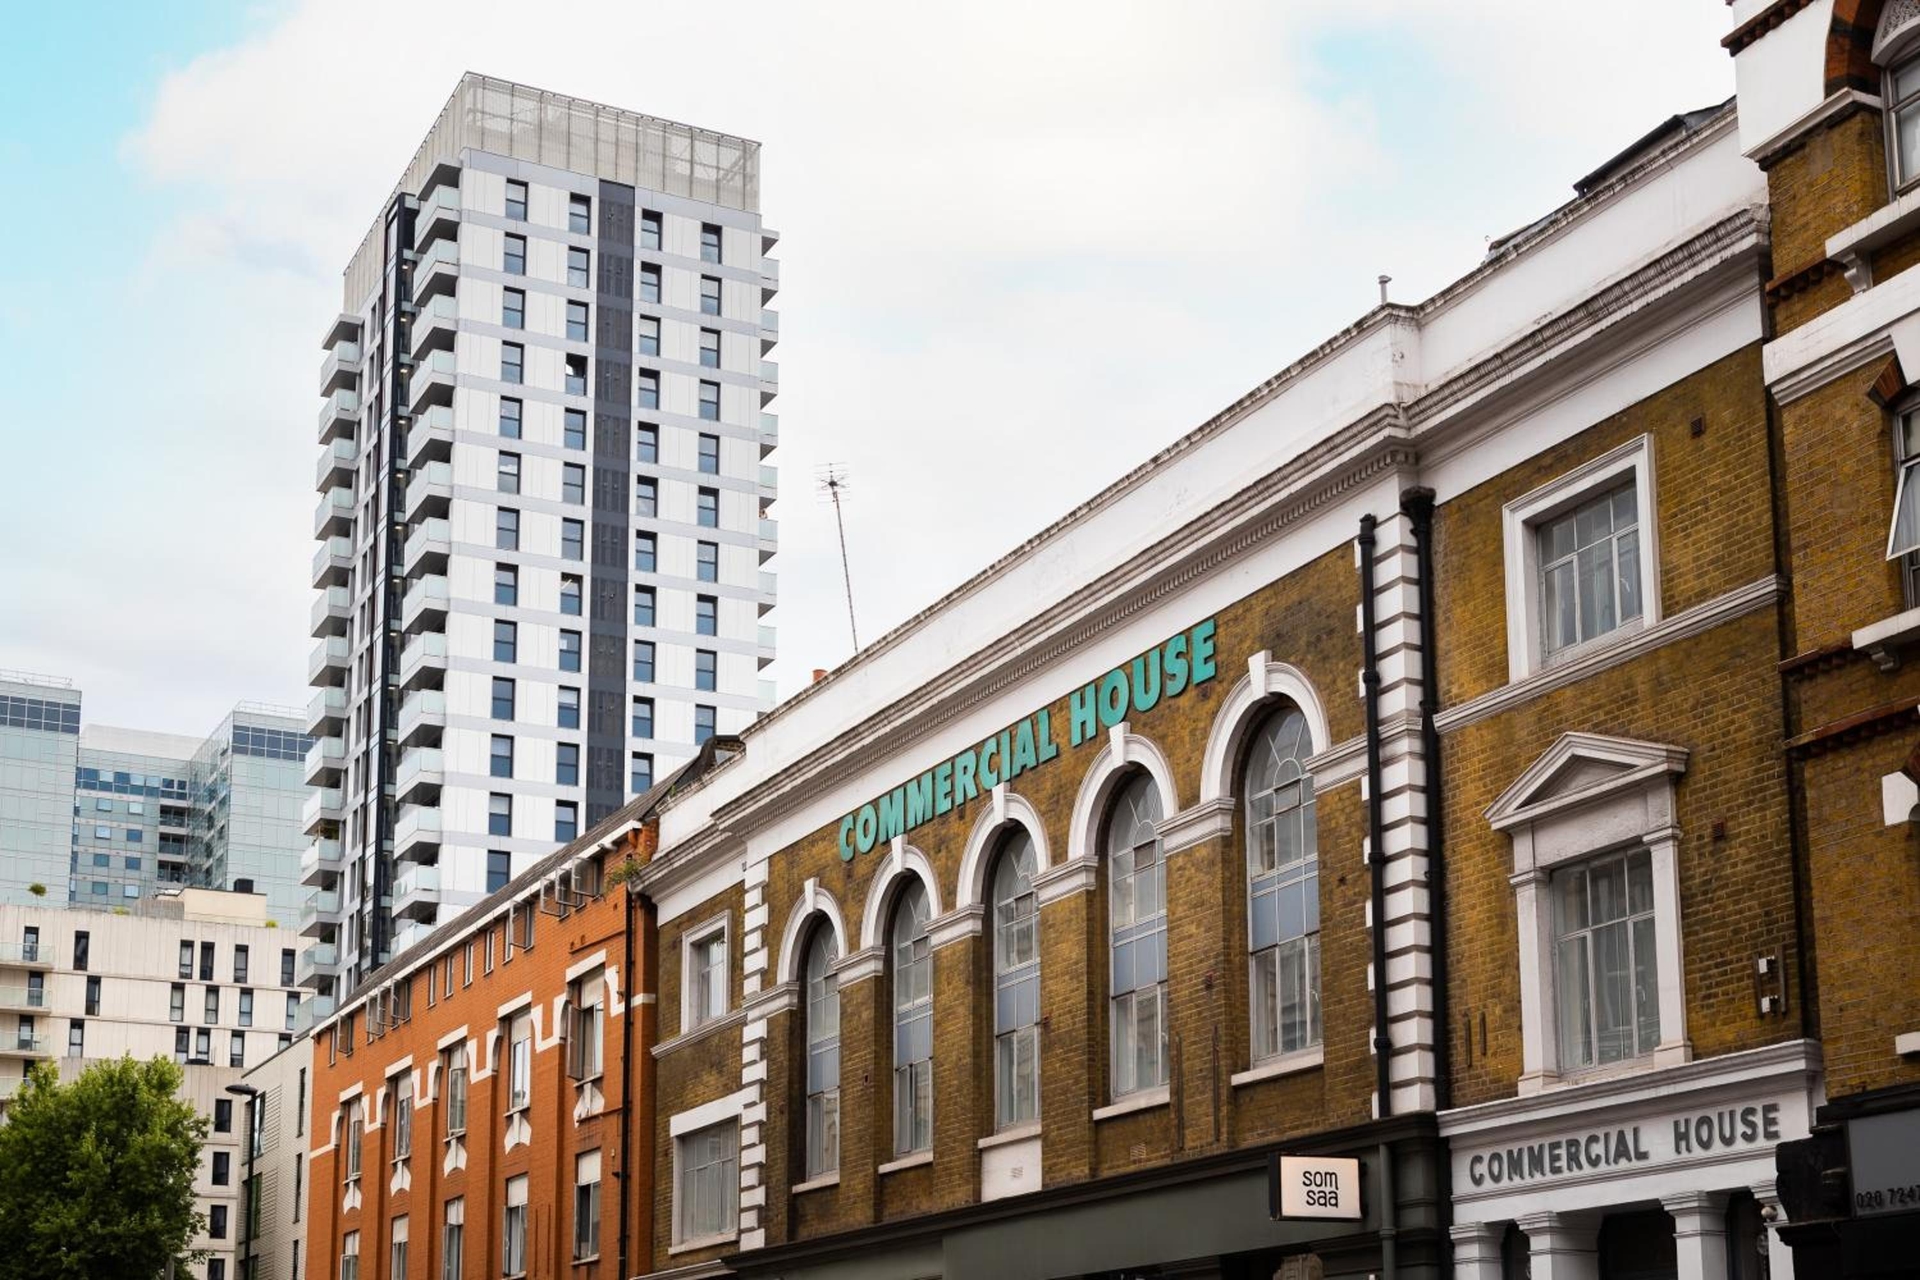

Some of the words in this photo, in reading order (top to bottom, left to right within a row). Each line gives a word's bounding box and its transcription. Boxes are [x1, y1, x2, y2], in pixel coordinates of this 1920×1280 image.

[838, 707, 1058, 862] COMMERCIAL
[1069, 618, 1217, 748] HOUSE
[1469, 1126, 1650, 1188] COMMERCIAL
[1673, 1103, 1781, 1155] HOUSE
[1302, 1170, 1339, 1191] som
[1306, 1189, 1339, 1208] saa
[1856, 1190, 1882, 1209] 020
